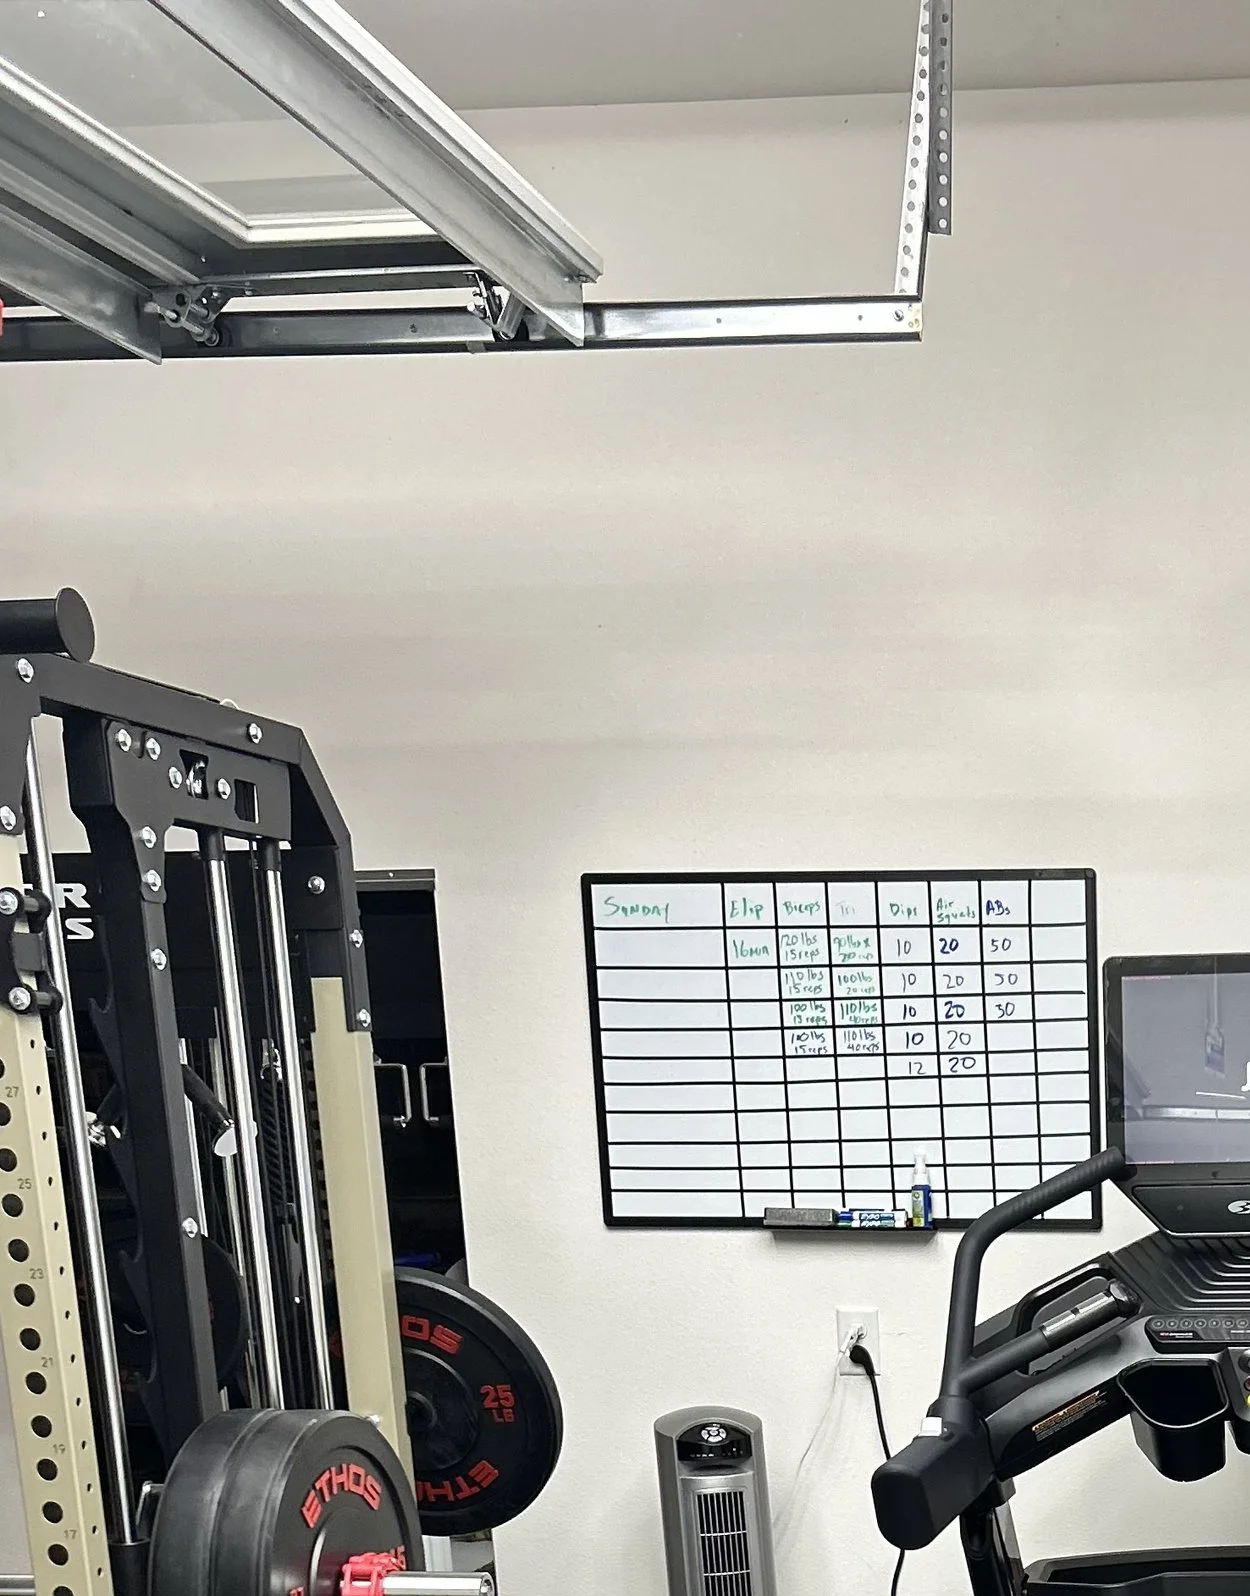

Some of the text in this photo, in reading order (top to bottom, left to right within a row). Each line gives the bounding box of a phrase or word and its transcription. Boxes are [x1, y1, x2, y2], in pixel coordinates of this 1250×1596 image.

[783, 901, 821, 916] Biceps
[890, 903, 918, 920] Dips
[936, 897, 954, 912] Air
[986, 899, 1011, 916] ABs
[897, 938, 912, 957] 10
[939, 937, 959, 955] 20
[990, 937, 1012, 953] 50
[901, 973, 917, 993] 10
[942, 973, 965, 989] 20
[903, 1003, 917, 1020] 10
[944, 1000, 966, 1019] 20
[905, 1031, 924, 1050] 10
[947, 1030, 972, 1050] 20
[908, 1061, 927, 1074] 12
[948, 1056, 976, 1073] 20
[5, 1086, 19, 1098] 27
[17, 1178, 32, 1190] 25
[29, 1267, 44, 1279] 23
[41, 1357, 53, 1368] 21
[480, 1384, 515, 1409] 25
[493, 1408, 515, 1423] LB
[301, 1463, 382, 1529] ETHOS
[63, 1529, 77, 1540] 17
